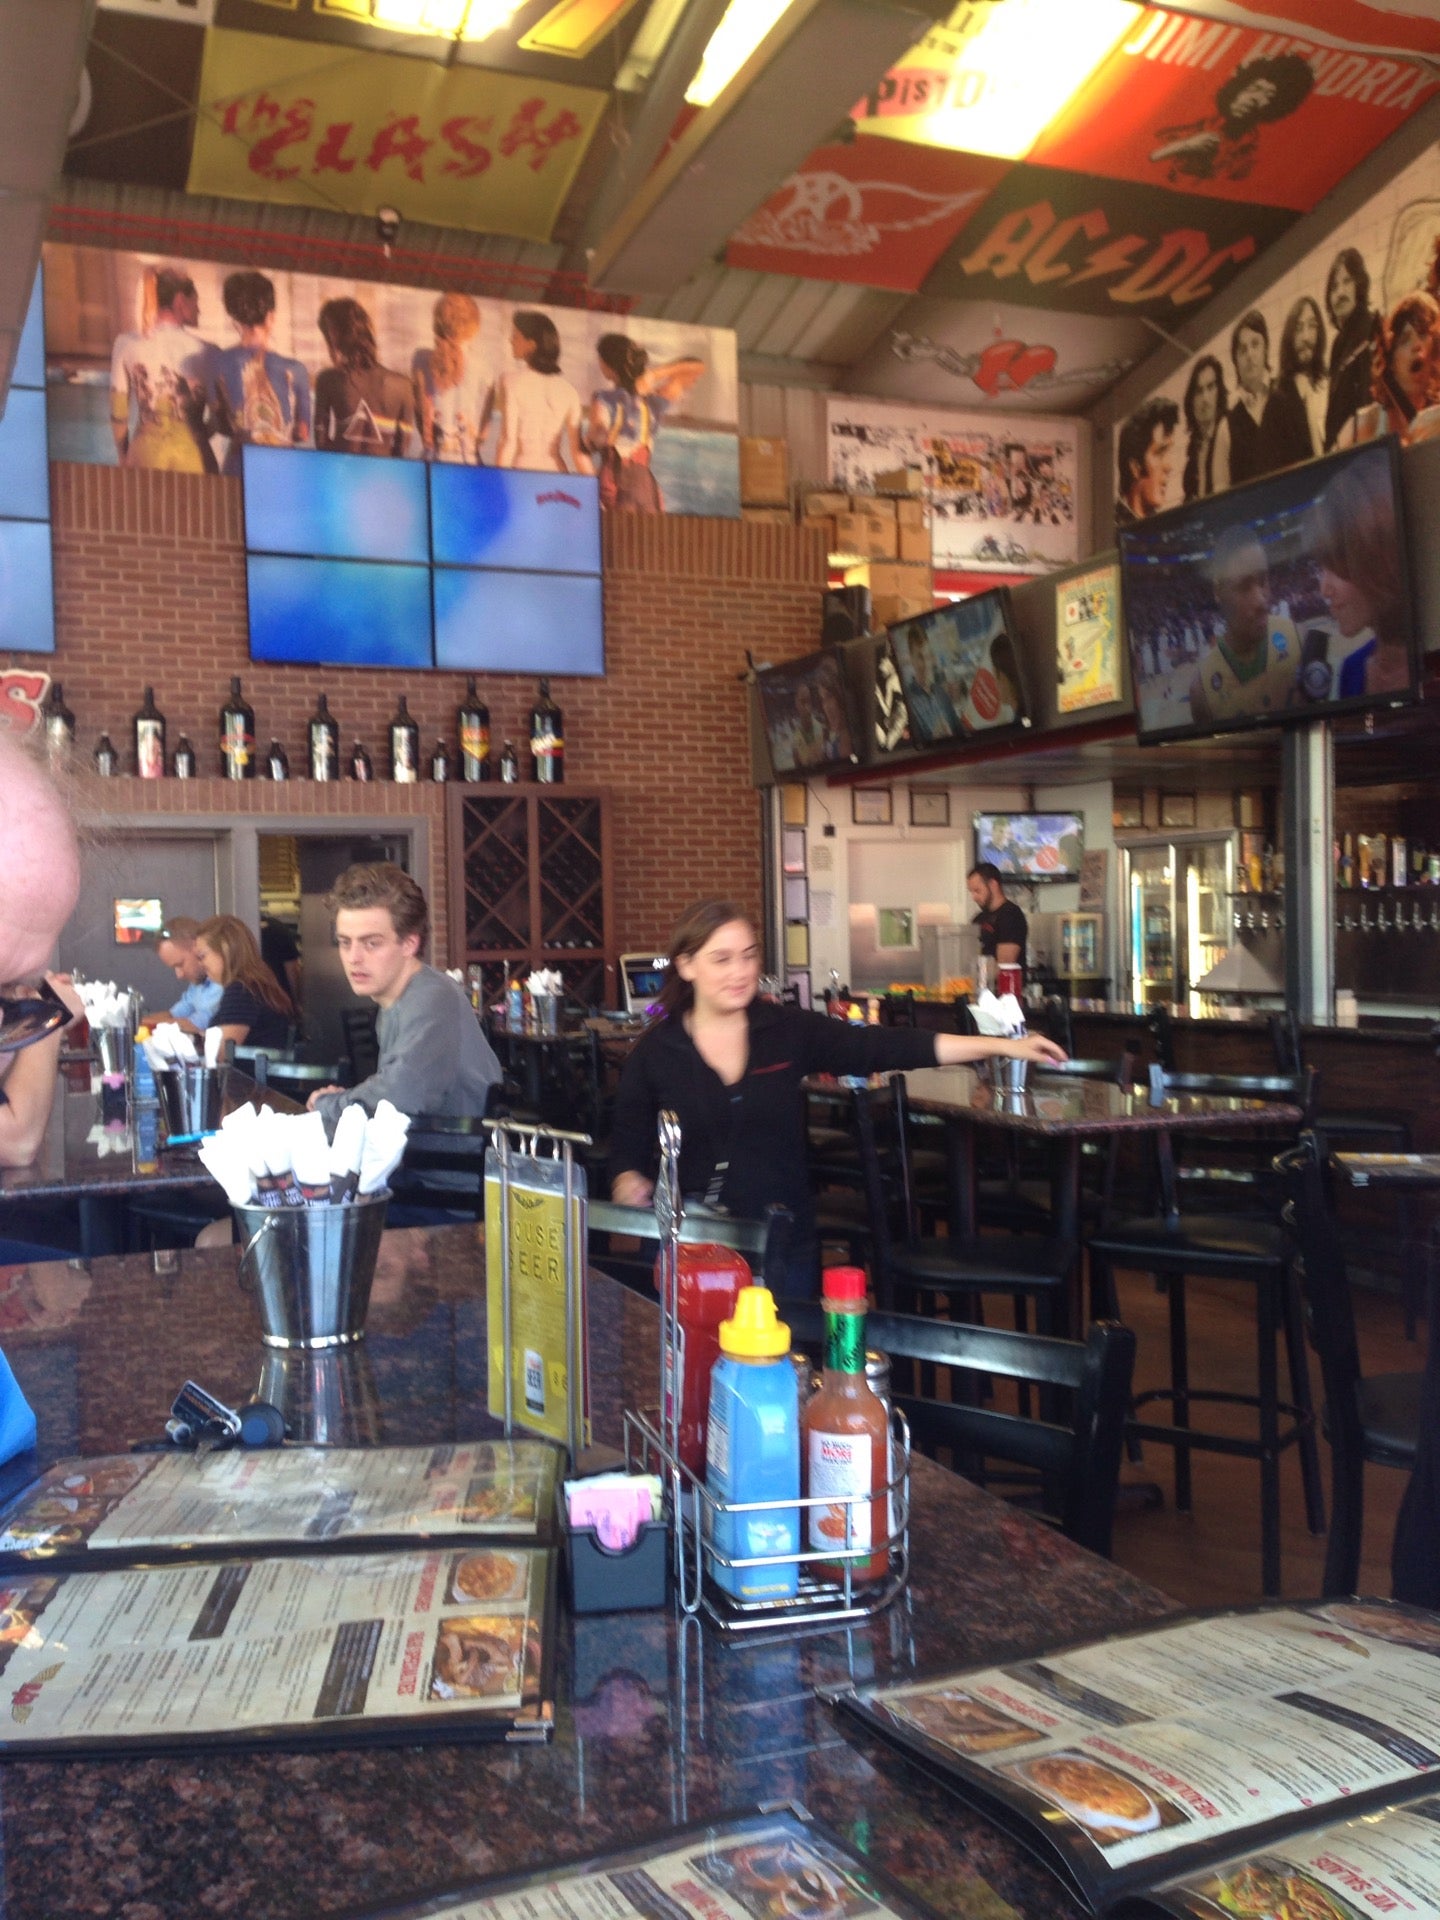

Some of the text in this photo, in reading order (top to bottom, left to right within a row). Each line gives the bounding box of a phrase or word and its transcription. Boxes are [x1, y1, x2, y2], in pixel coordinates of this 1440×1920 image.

[1122, 9, 1438, 110] JIMI HNDRIX
[248, 97, 582, 184] CLASH
[507, 1215, 560, 1251] OUSE
[508, 1247, 560, 1282] EER
[1363, 1892, 1398, 1913] VIP
